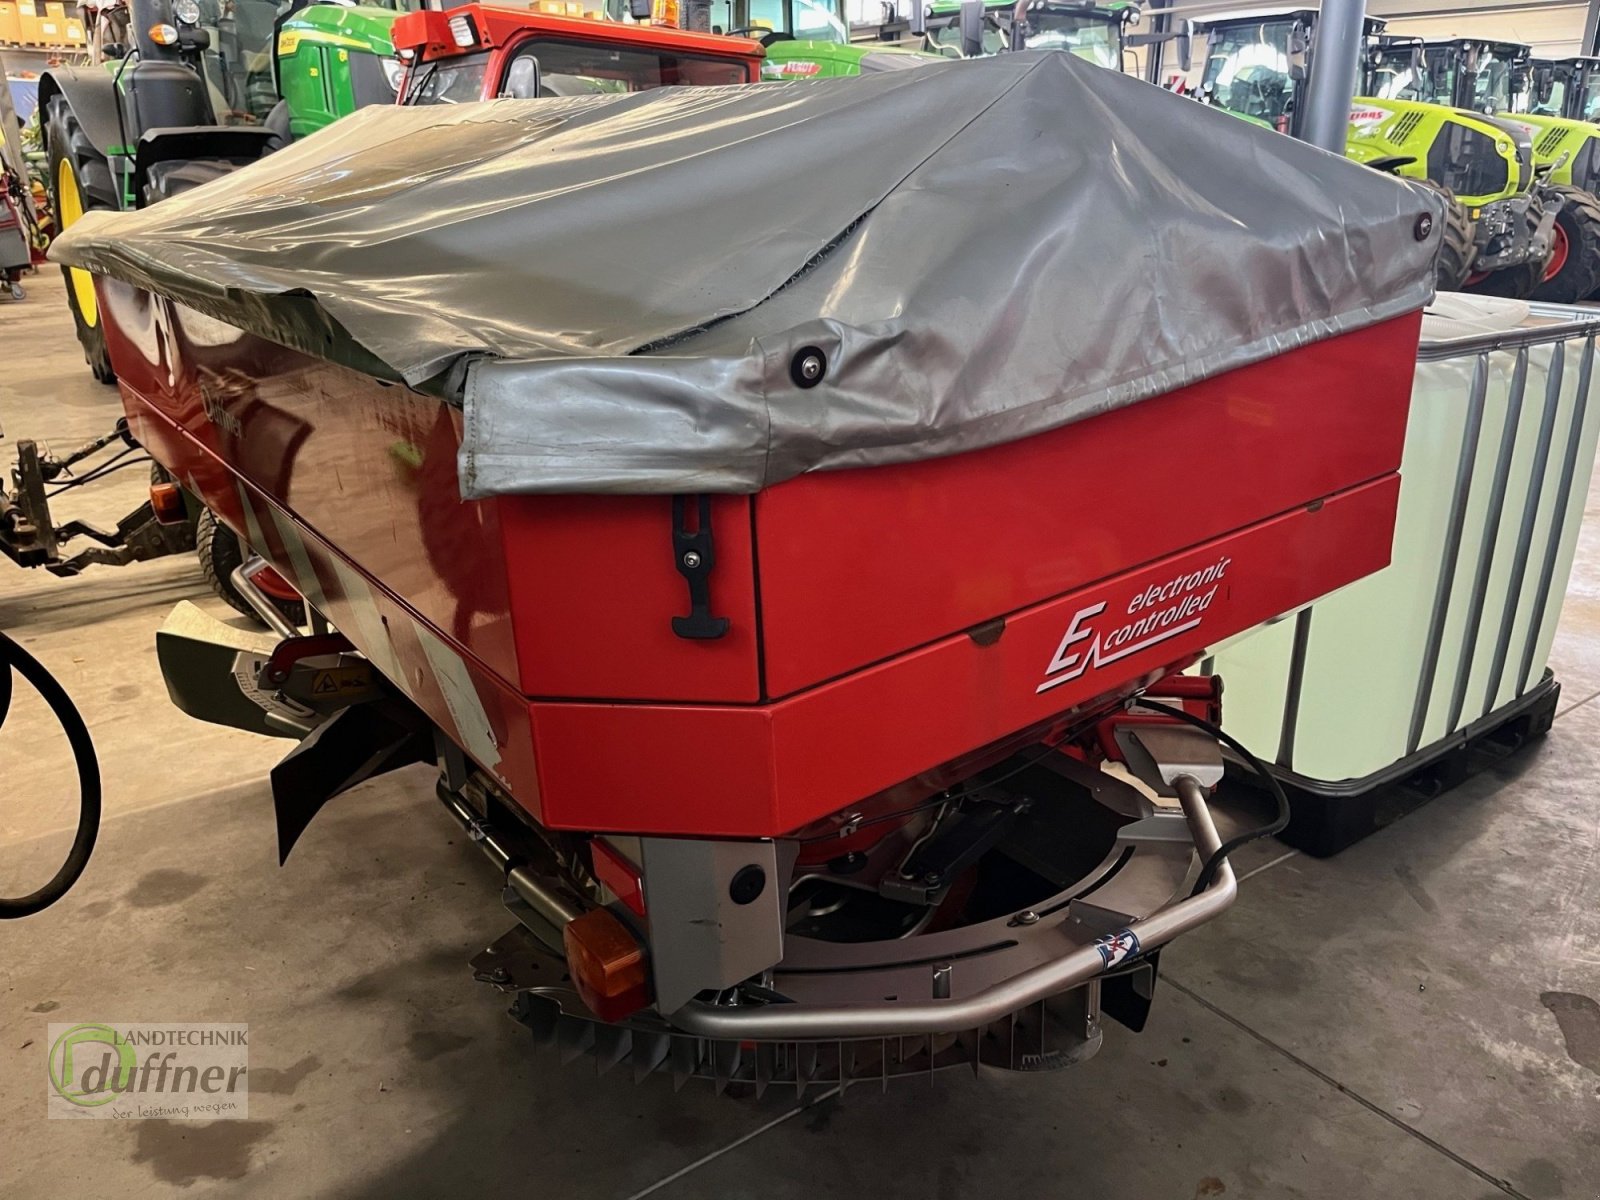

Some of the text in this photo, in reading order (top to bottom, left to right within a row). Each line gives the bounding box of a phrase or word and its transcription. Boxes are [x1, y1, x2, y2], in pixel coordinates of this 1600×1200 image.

[1349, 111, 1384, 122] CLAAS
[1127, 556, 1232, 615] electronic
[1103, 584, 1219, 651] controlled
